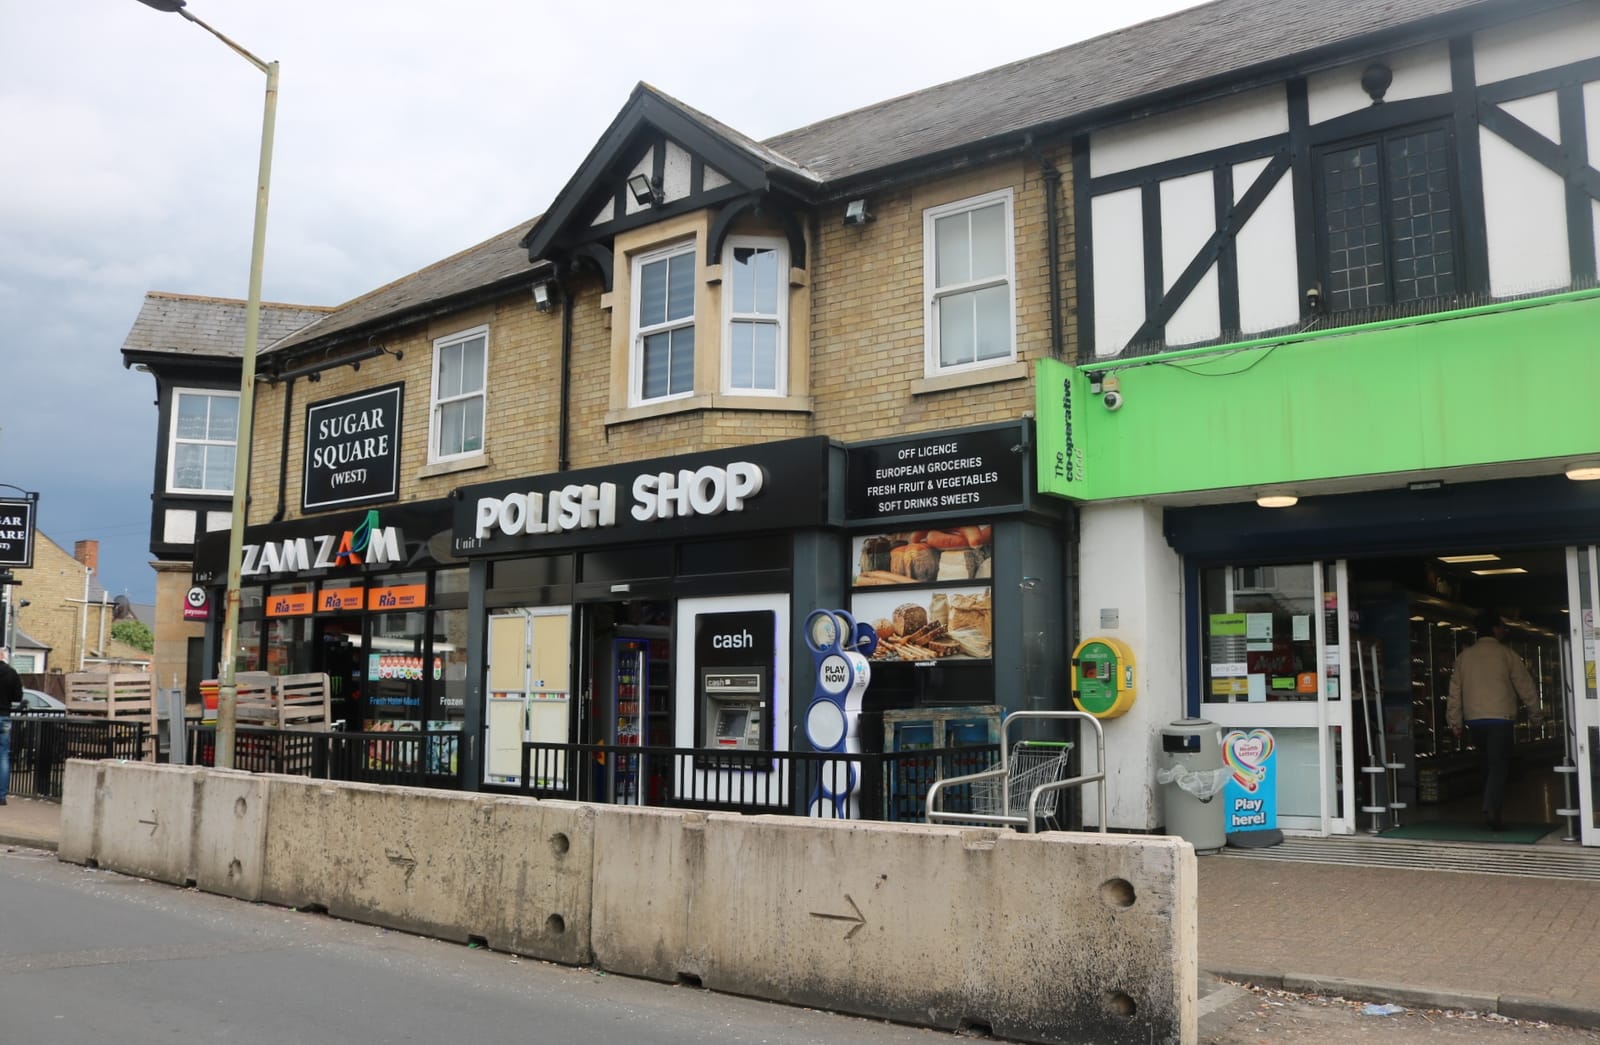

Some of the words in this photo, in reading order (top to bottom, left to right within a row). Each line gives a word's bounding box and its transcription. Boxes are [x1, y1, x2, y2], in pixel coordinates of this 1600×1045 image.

[319, 408, 384, 440] SUGAR
[1063, 378, 1074, 482] co-operative
[313, 435, 389, 469] SQUARE
[898, 448, 916, 460] OFF
[918, 442, 958, 457] LICENCE
[875, 463, 925, 479] EUROPEAN
[927, 457, 982, 473] GROCERIES
[1055, 451, 1064, 479] The
[331, 468, 367, 488] (WEST)
[867, 484, 897, 497] FRESH
[898, 480, 925, 493] FRUIT
[927, 480, 934, 490] &
[936, 471, 998, 489] VEGETABLES
[475, 482, 617, 540] POLISH
[630, 461, 763, 521] SHOP
[878, 500, 902, 512] SOFT
[904, 496, 938, 510] DRINKS
[940, 492, 980, 506] SWEETS
[0, 516, 22, 526] AR
[456, 536, 475, 550] Unit
[275, 600, 290, 613] Ria
[325, 594, 341, 608] Ria
[379, 593, 396, 607] Ria
[713, 629, 753, 648] cash
[825, 665, 845, 674] PLAY
[707, 678, 724, 687] cash
[825, 674, 845, 683] NOW
[440, 696, 464, 706] Frozen
[1234, 798, 1263, 812] Play
[1231, 812, 1265, 826] here!
